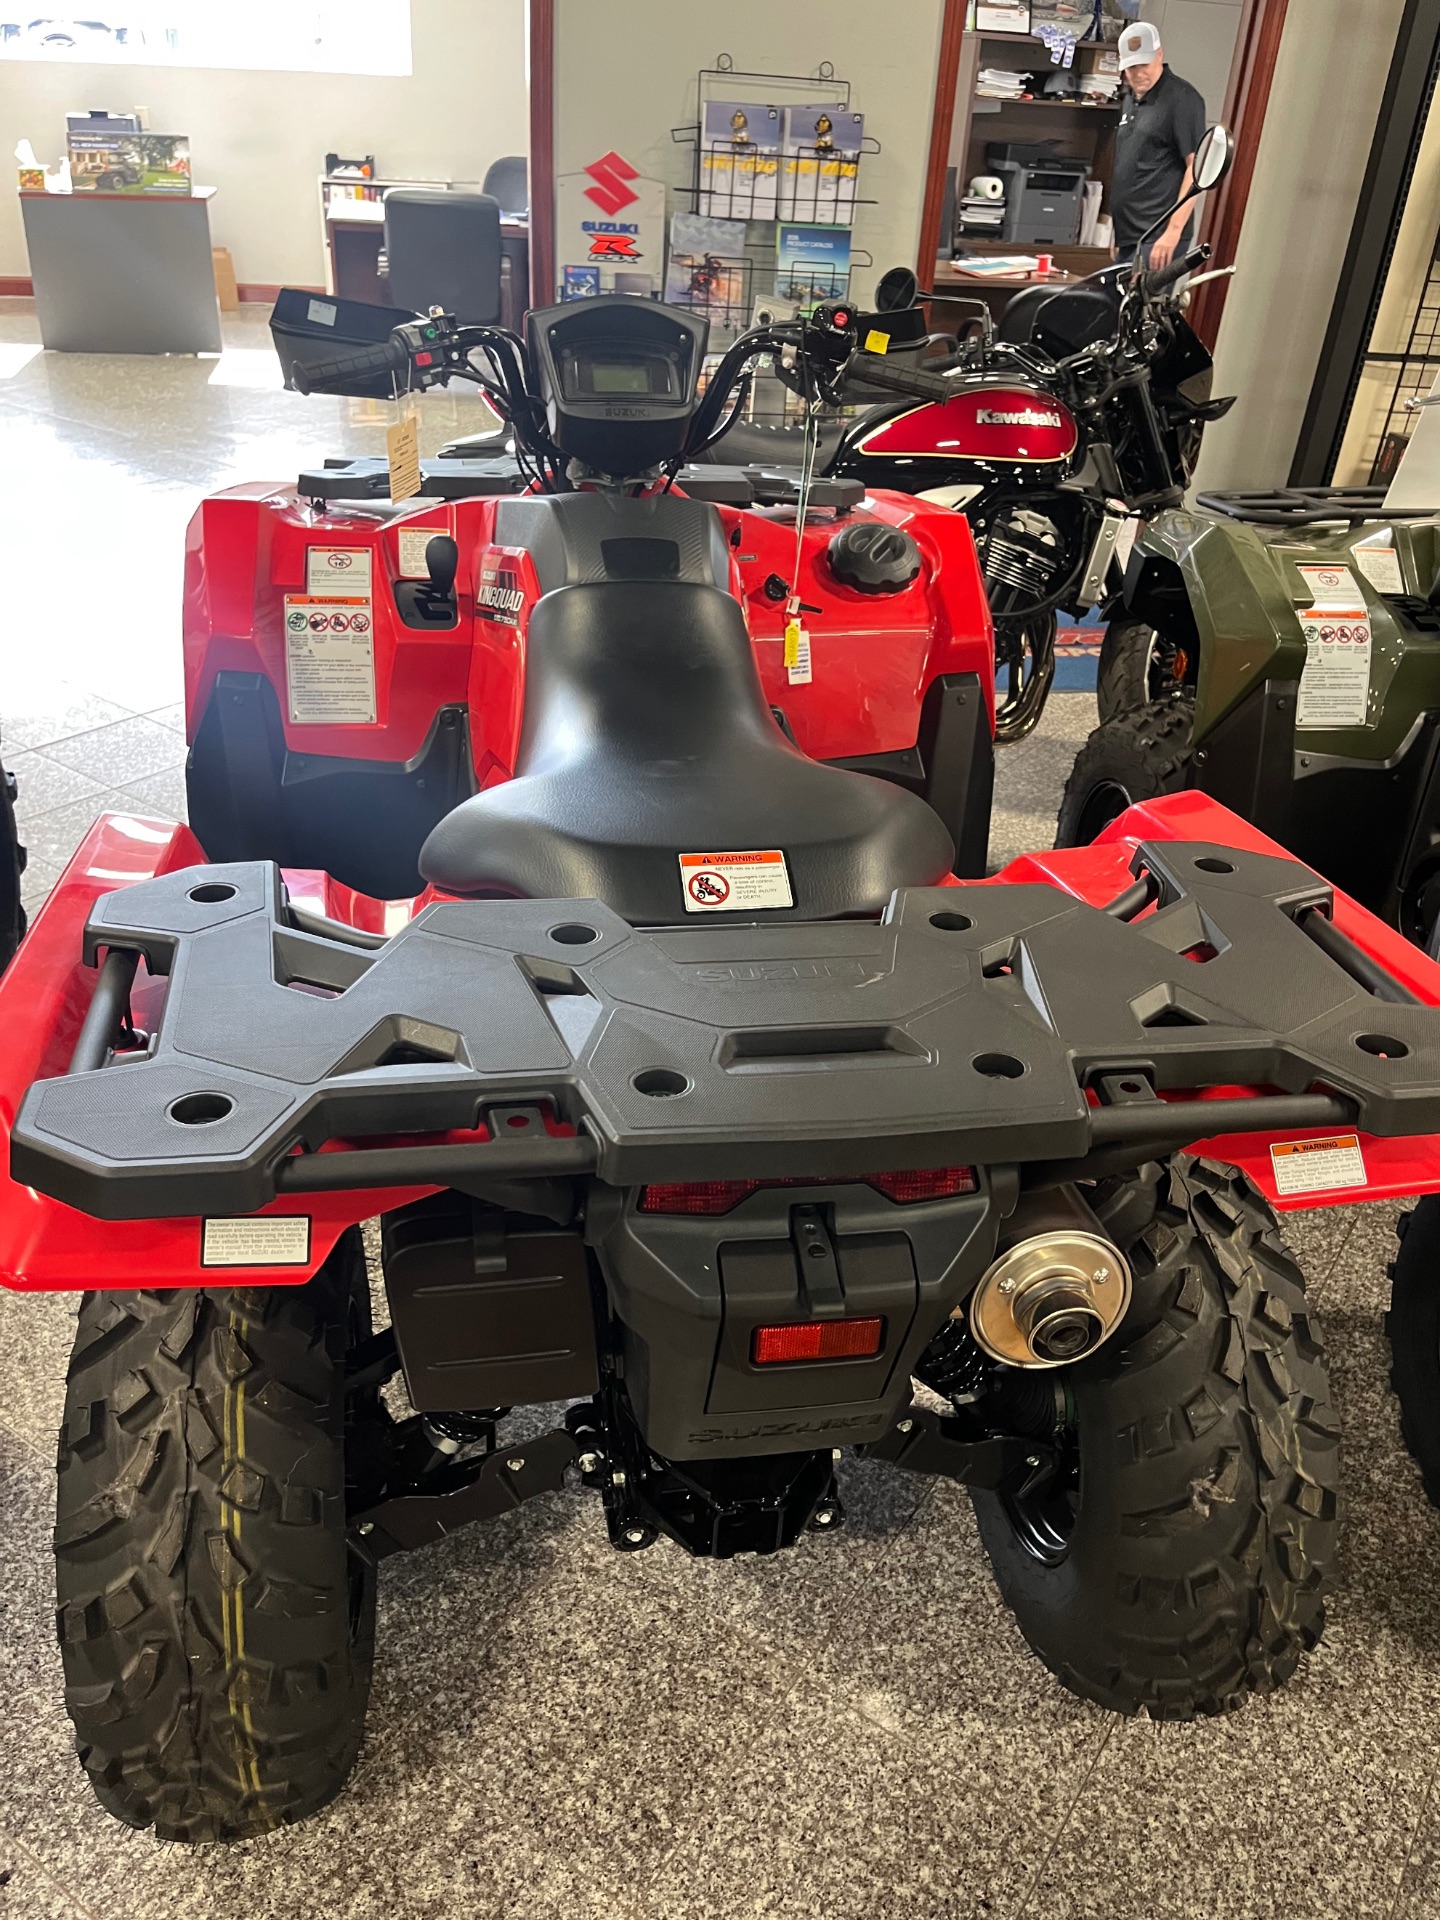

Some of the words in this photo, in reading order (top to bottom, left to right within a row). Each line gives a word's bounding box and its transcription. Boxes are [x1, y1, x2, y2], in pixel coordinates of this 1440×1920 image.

[582, 221, 638, 234] SUZUKI
[976, 408, 1062, 428] Kawasaki
[477, 584, 524, 612] KINGQUAD
[714, 854, 763, 863] WARNING
[1301, 1142, 1338, 1151] WARNING
[688, 1413, 884, 1443] SUZUKI
